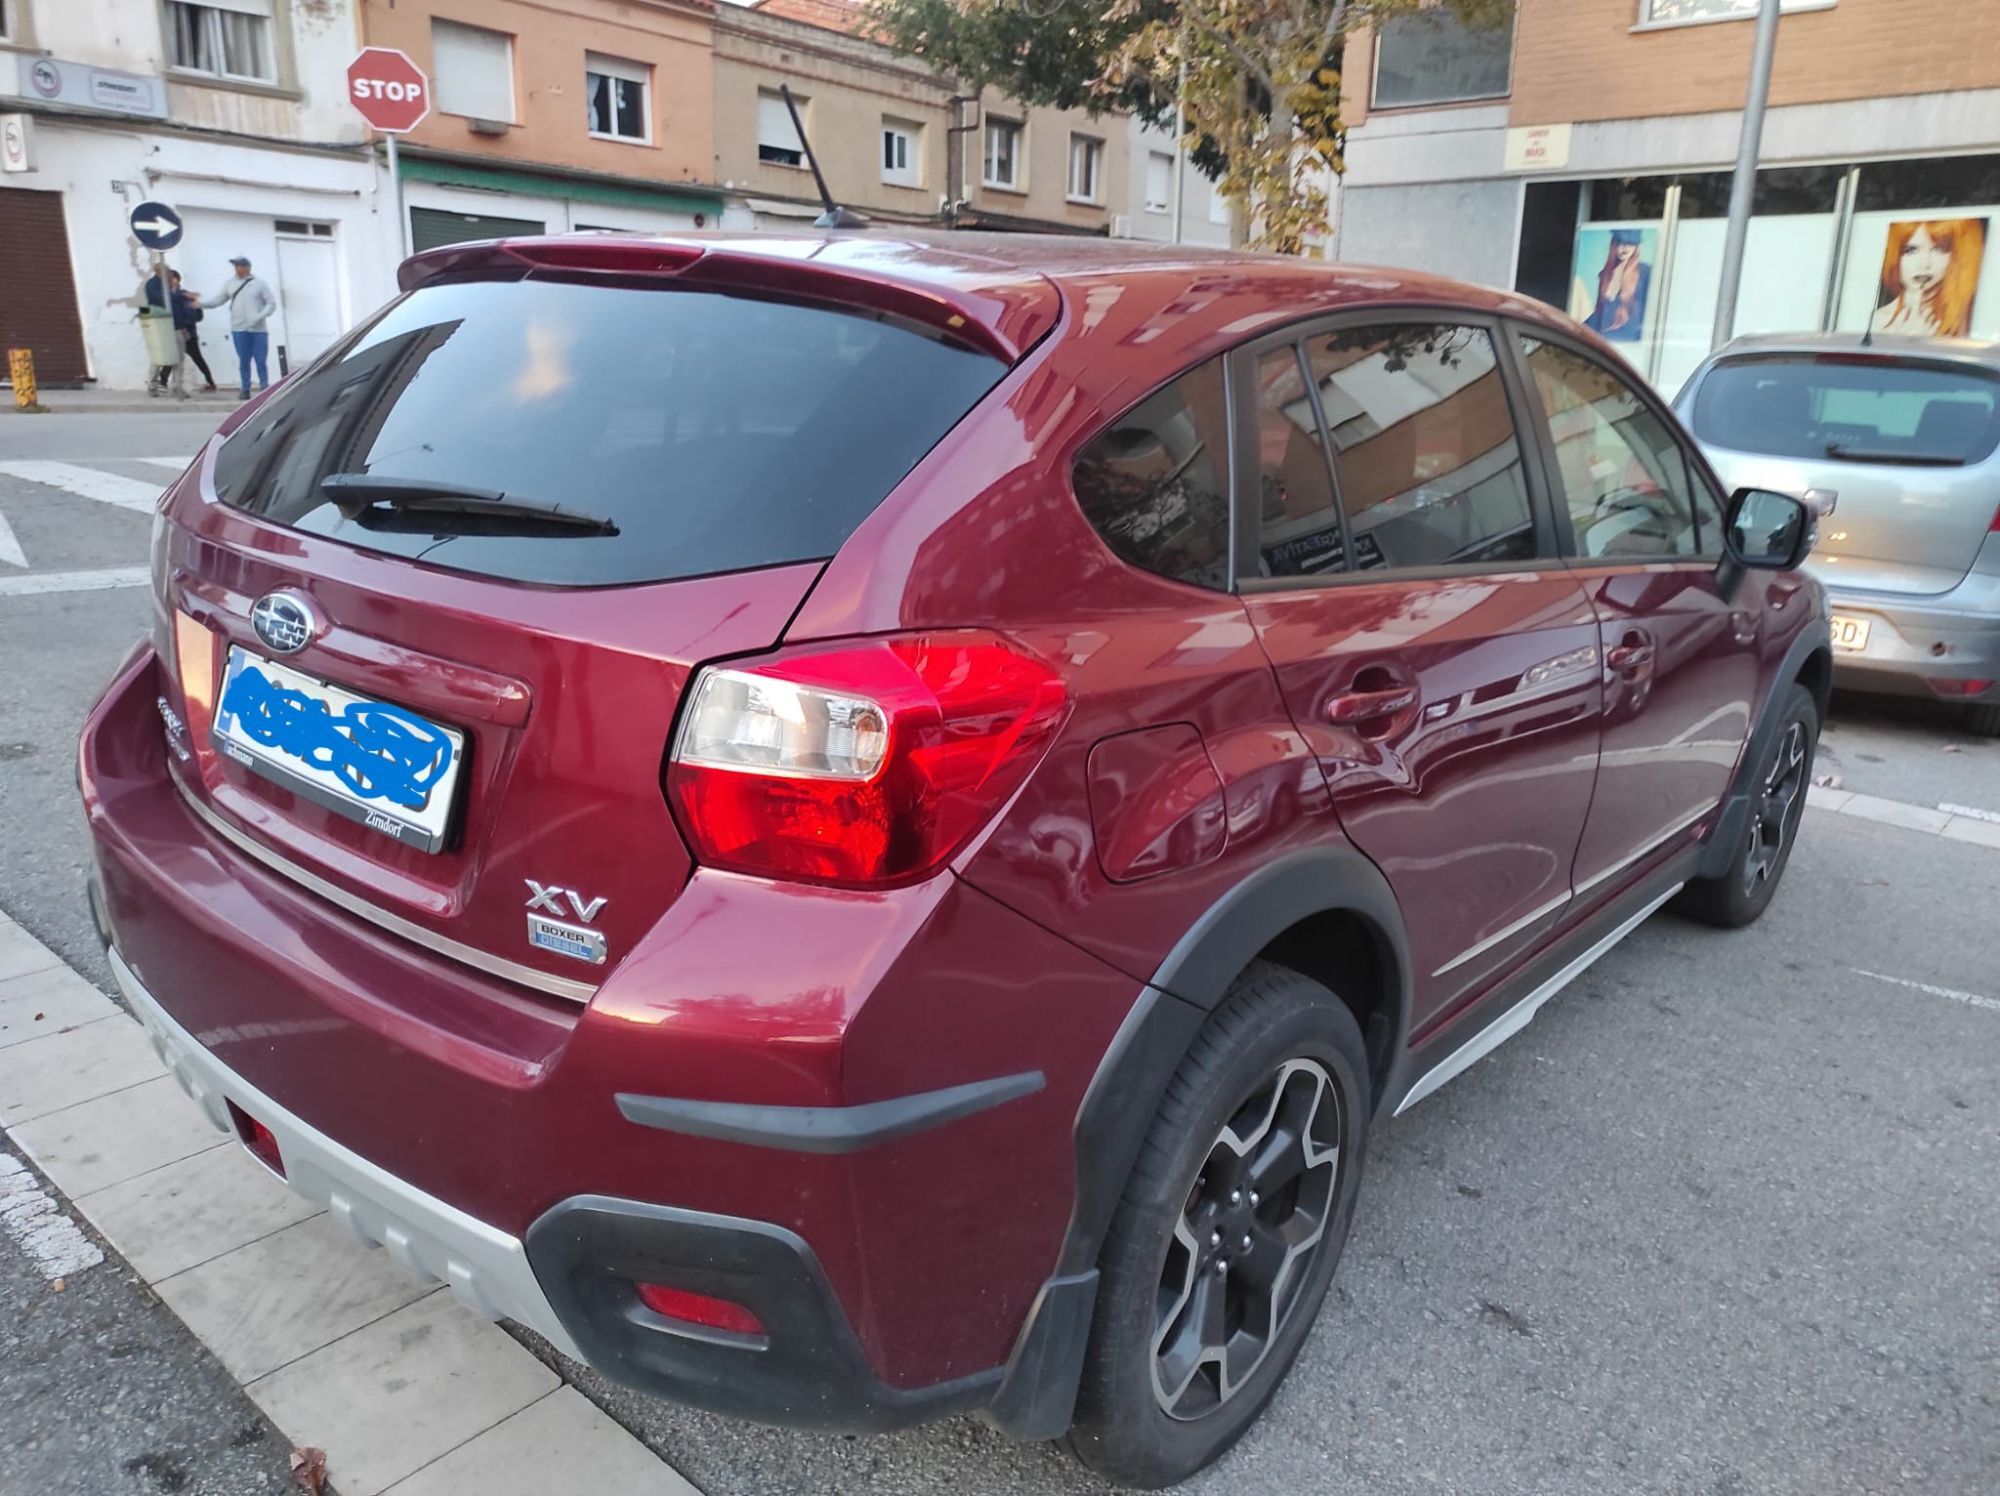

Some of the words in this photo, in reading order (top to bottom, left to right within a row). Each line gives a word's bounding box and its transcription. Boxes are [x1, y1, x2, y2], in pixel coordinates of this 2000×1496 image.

[353, 78, 421, 102] STOP
[365, 809, 404, 838] Zirndorf
[524, 879, 608, 923] XV
[540, 933, 589, 957] DIESEL
[541, 924, 585, 943] BOXER
